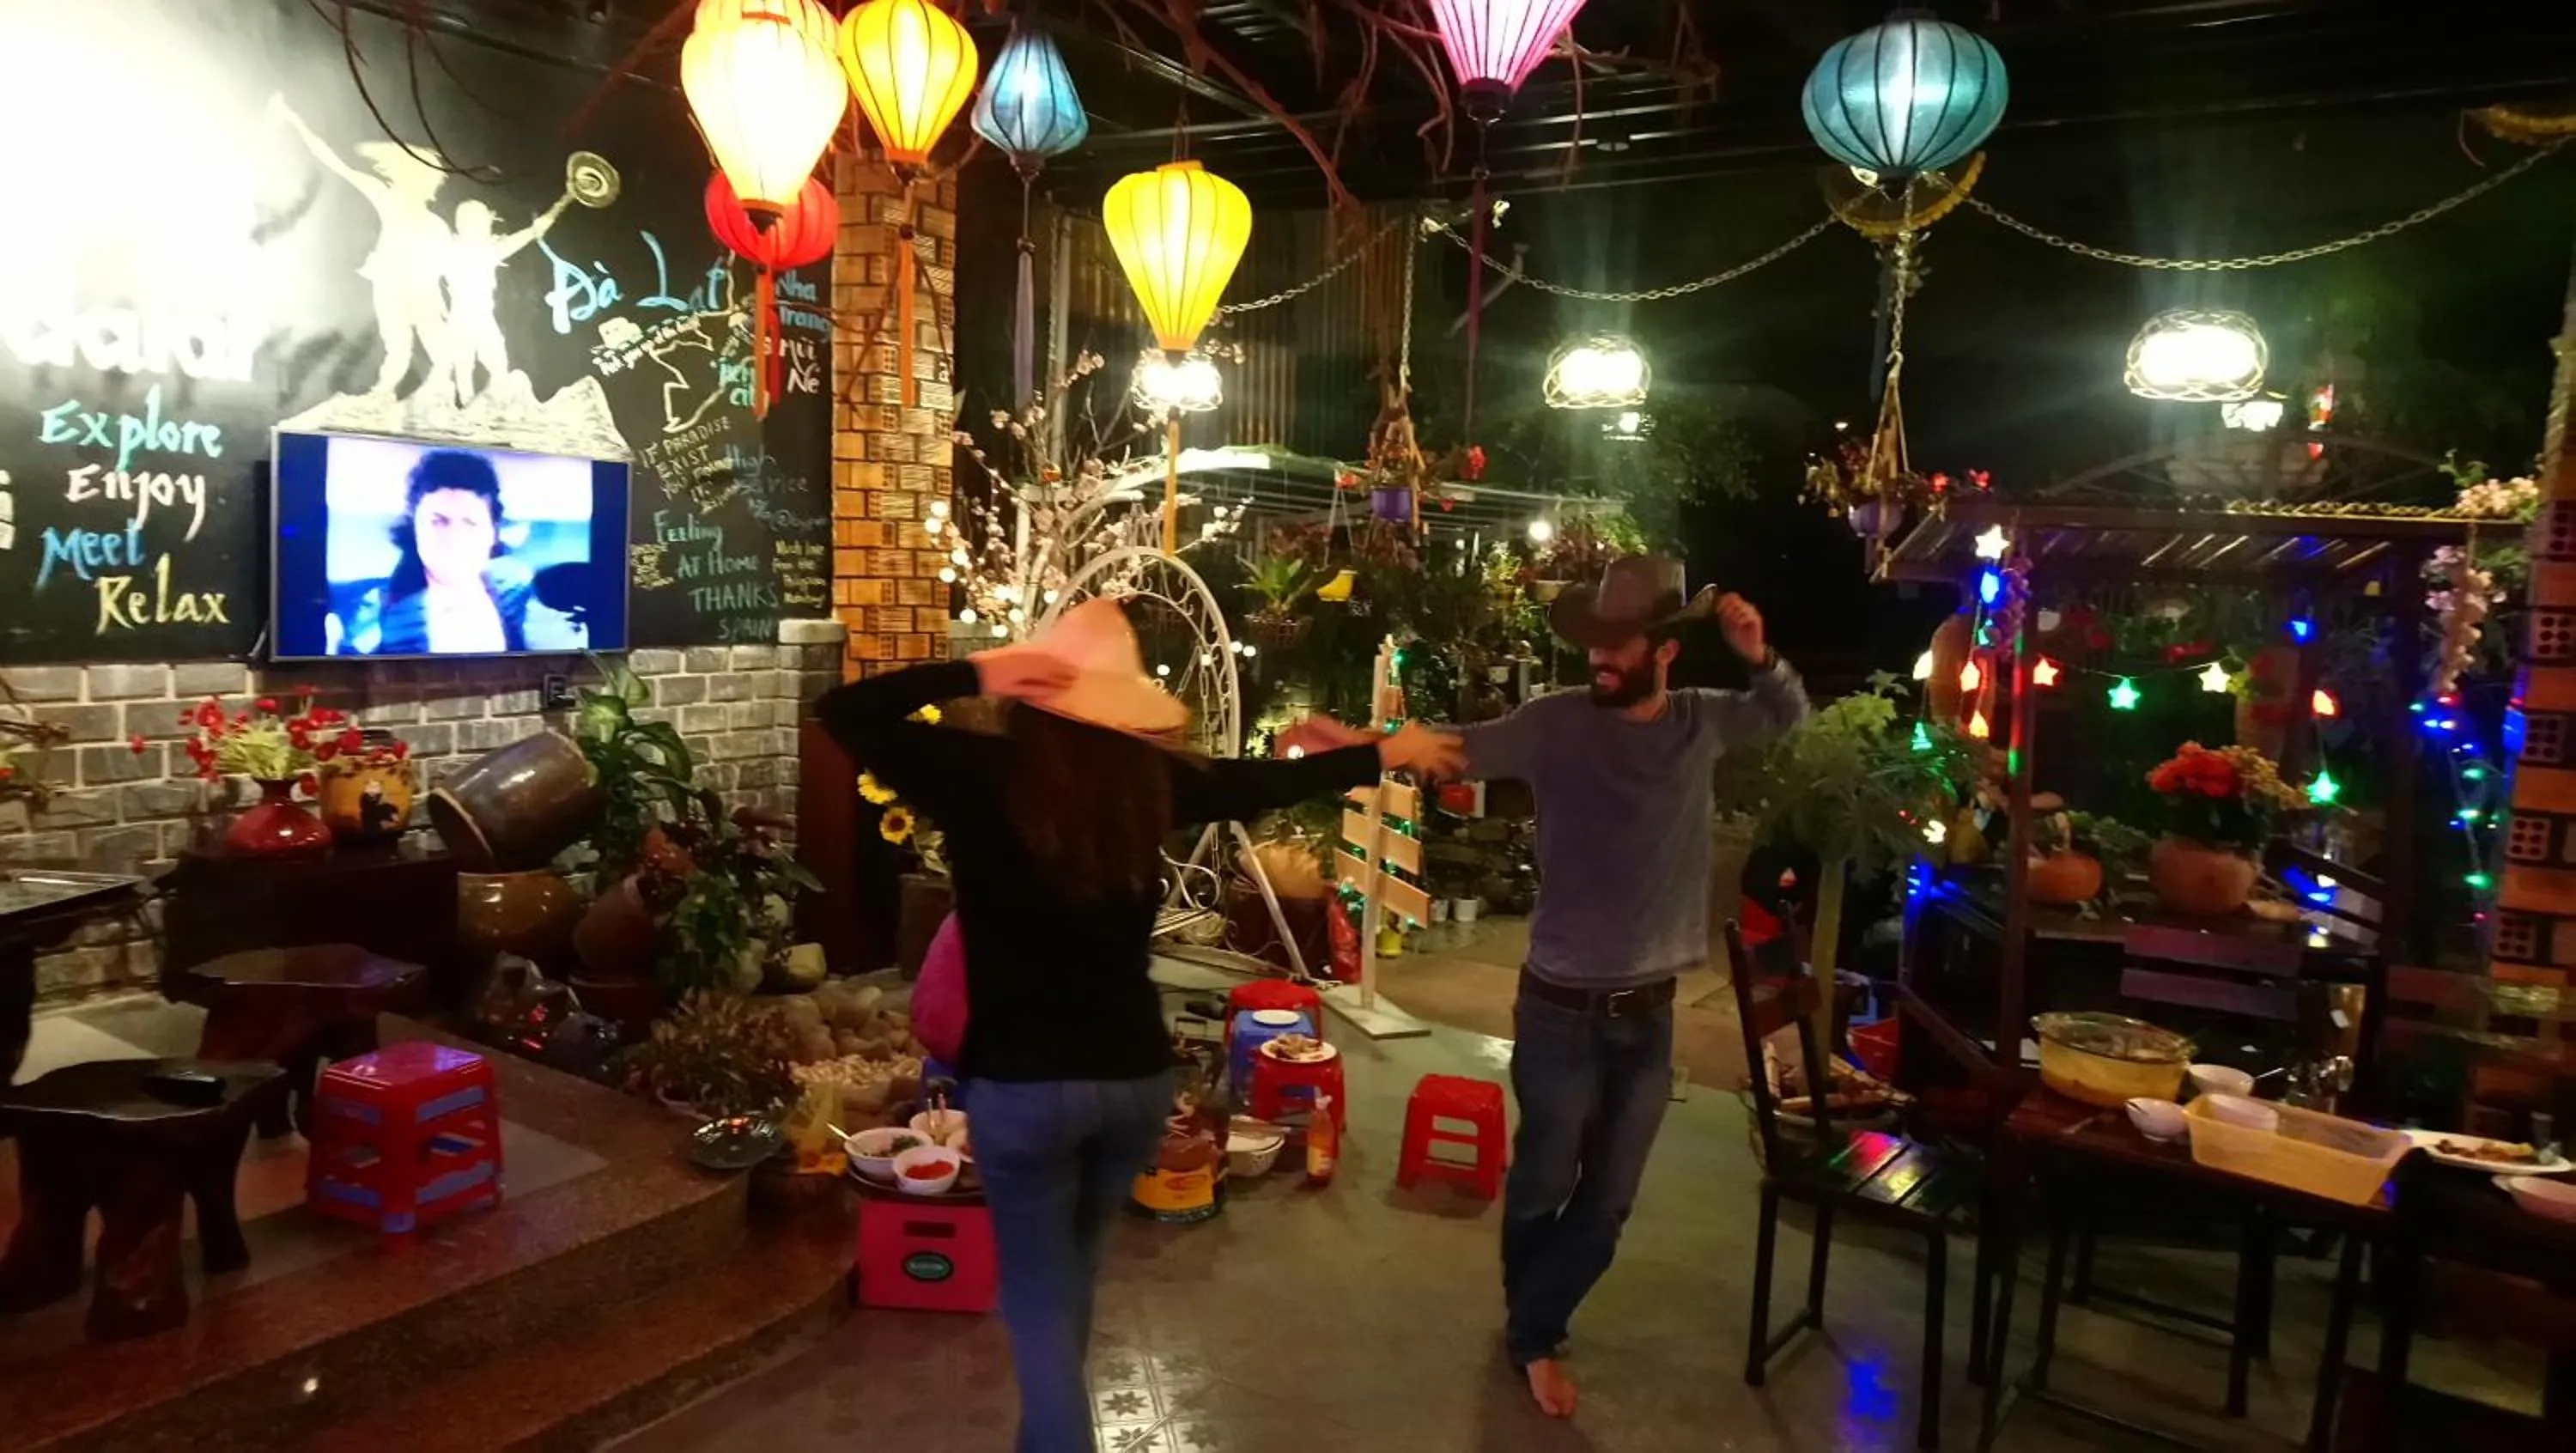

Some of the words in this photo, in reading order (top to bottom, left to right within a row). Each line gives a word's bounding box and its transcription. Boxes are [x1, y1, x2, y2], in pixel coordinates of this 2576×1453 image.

[39, 384, 223, 469] Explore
[65, 464, 205, 543] Enjoy
[37, 517, 146, 588] Meet
[95, 553, 230, 636] Relax
[687, 581, 780, 612] THANKS
